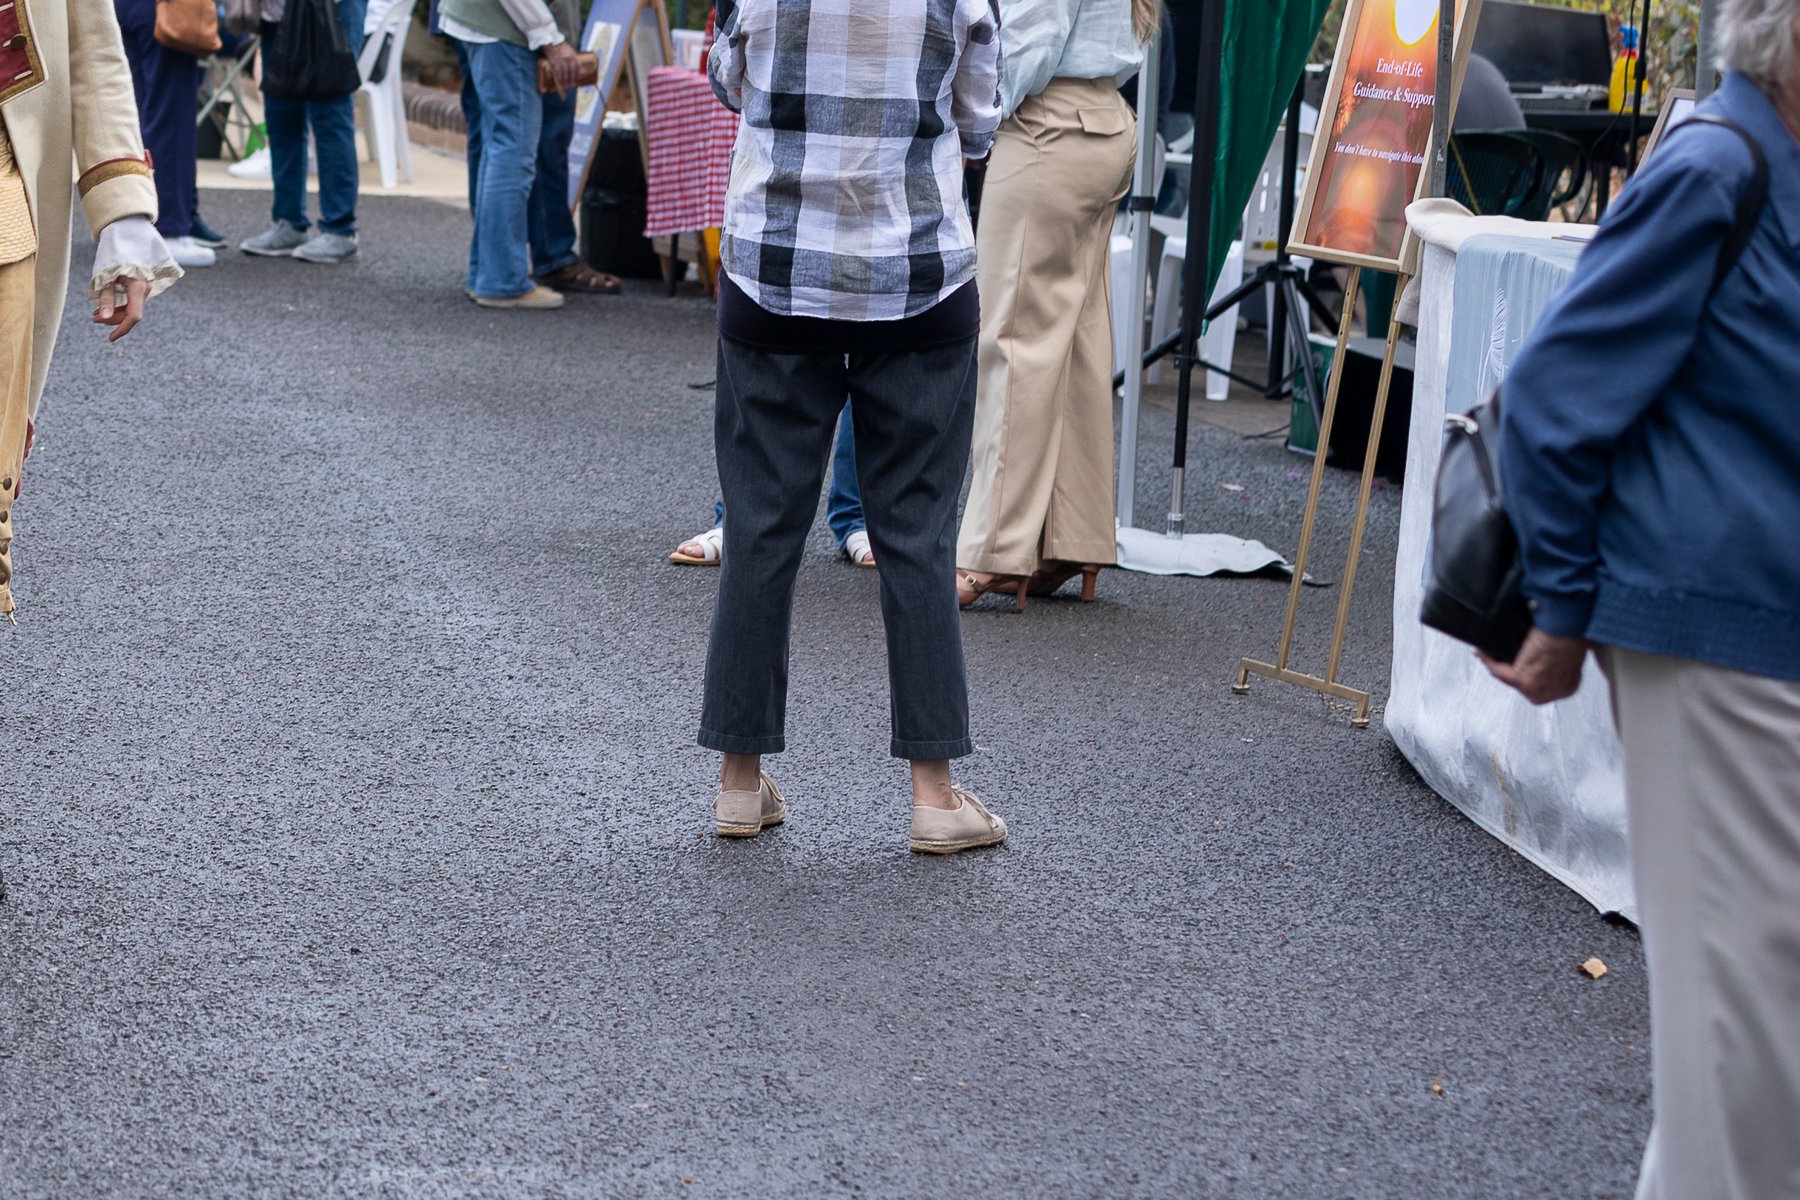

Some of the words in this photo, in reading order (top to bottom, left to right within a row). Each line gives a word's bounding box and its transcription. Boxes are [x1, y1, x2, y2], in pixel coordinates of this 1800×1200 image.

[1375, 57, 1424, 78] End-of-Life
[1353, 81, 1393, 100] Guidance
[1393, 86, 1403, 102] &
